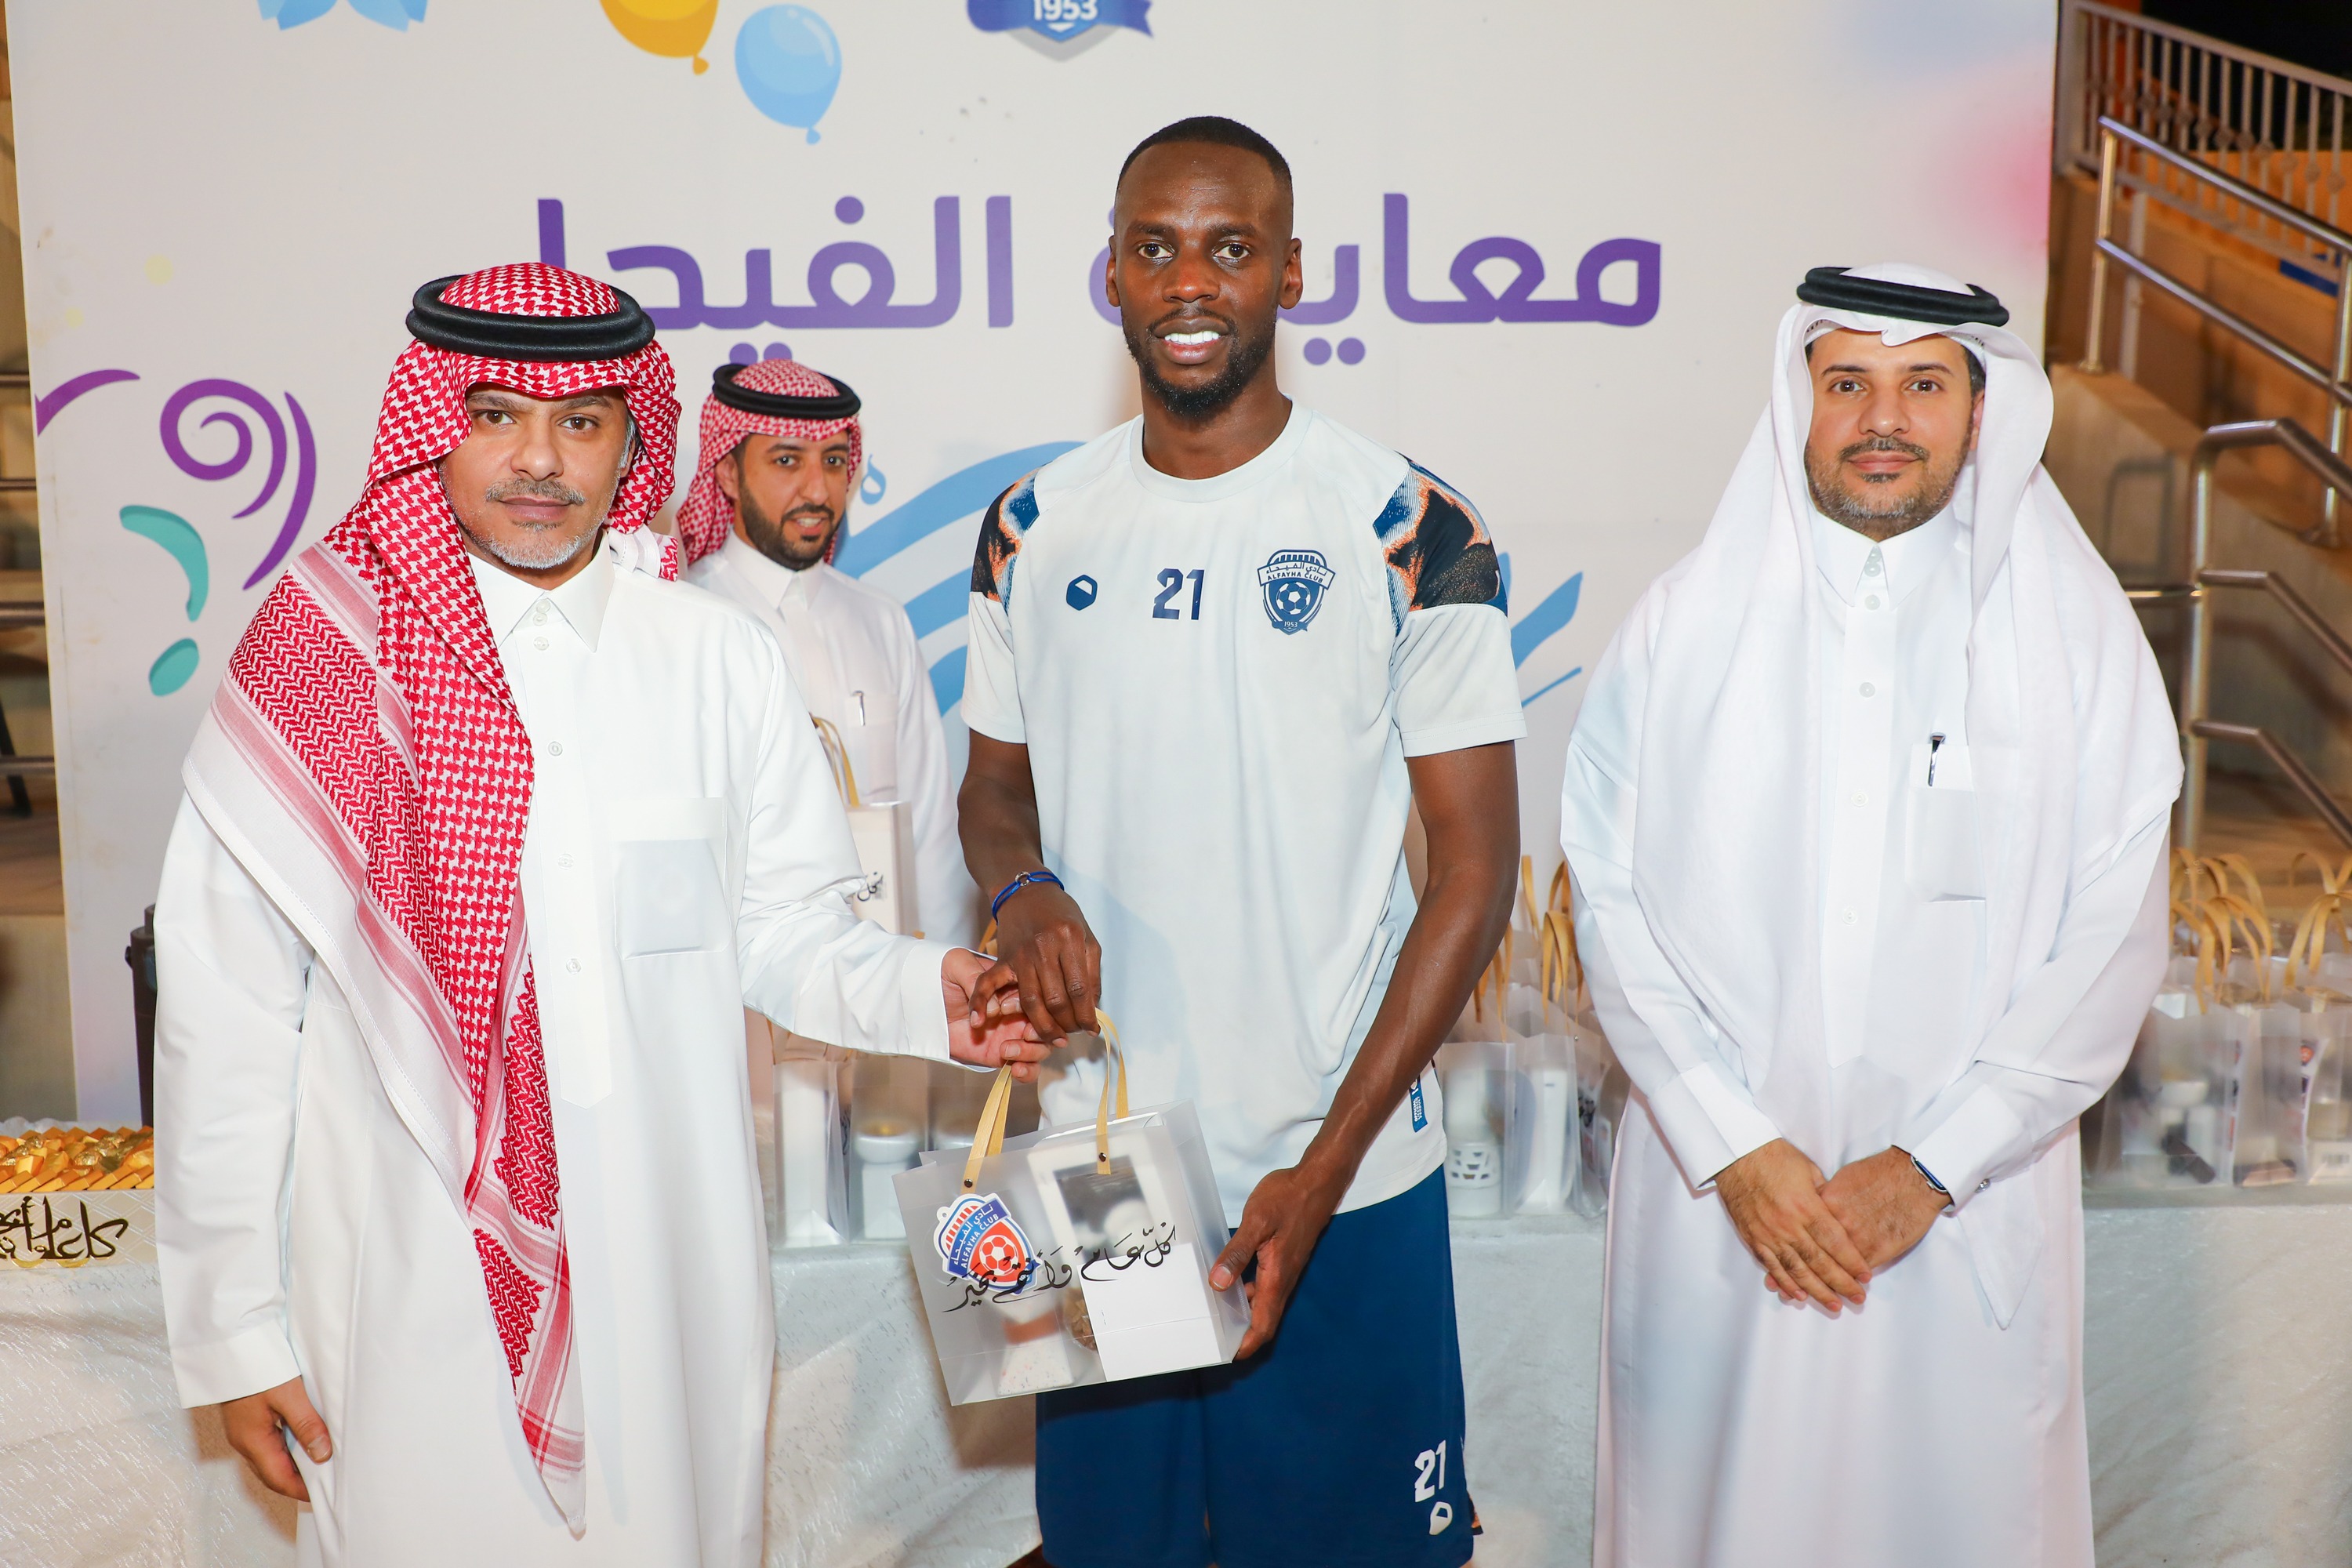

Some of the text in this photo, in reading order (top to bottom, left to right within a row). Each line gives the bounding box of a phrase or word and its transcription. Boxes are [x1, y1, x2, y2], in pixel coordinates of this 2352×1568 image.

[537, 193, 1661, 365] معاي الفيحا
[1152, 568, 1205, 620] 21
[1267, 571, 1323, 583] ALFAYHA CLUB
[950, 1203, 993, 1265] نادي الفيحاء
[960, 1213, 1000, 1269] ALFAYHA CLUB
[1414, 1439, 1446, 1503] 21
